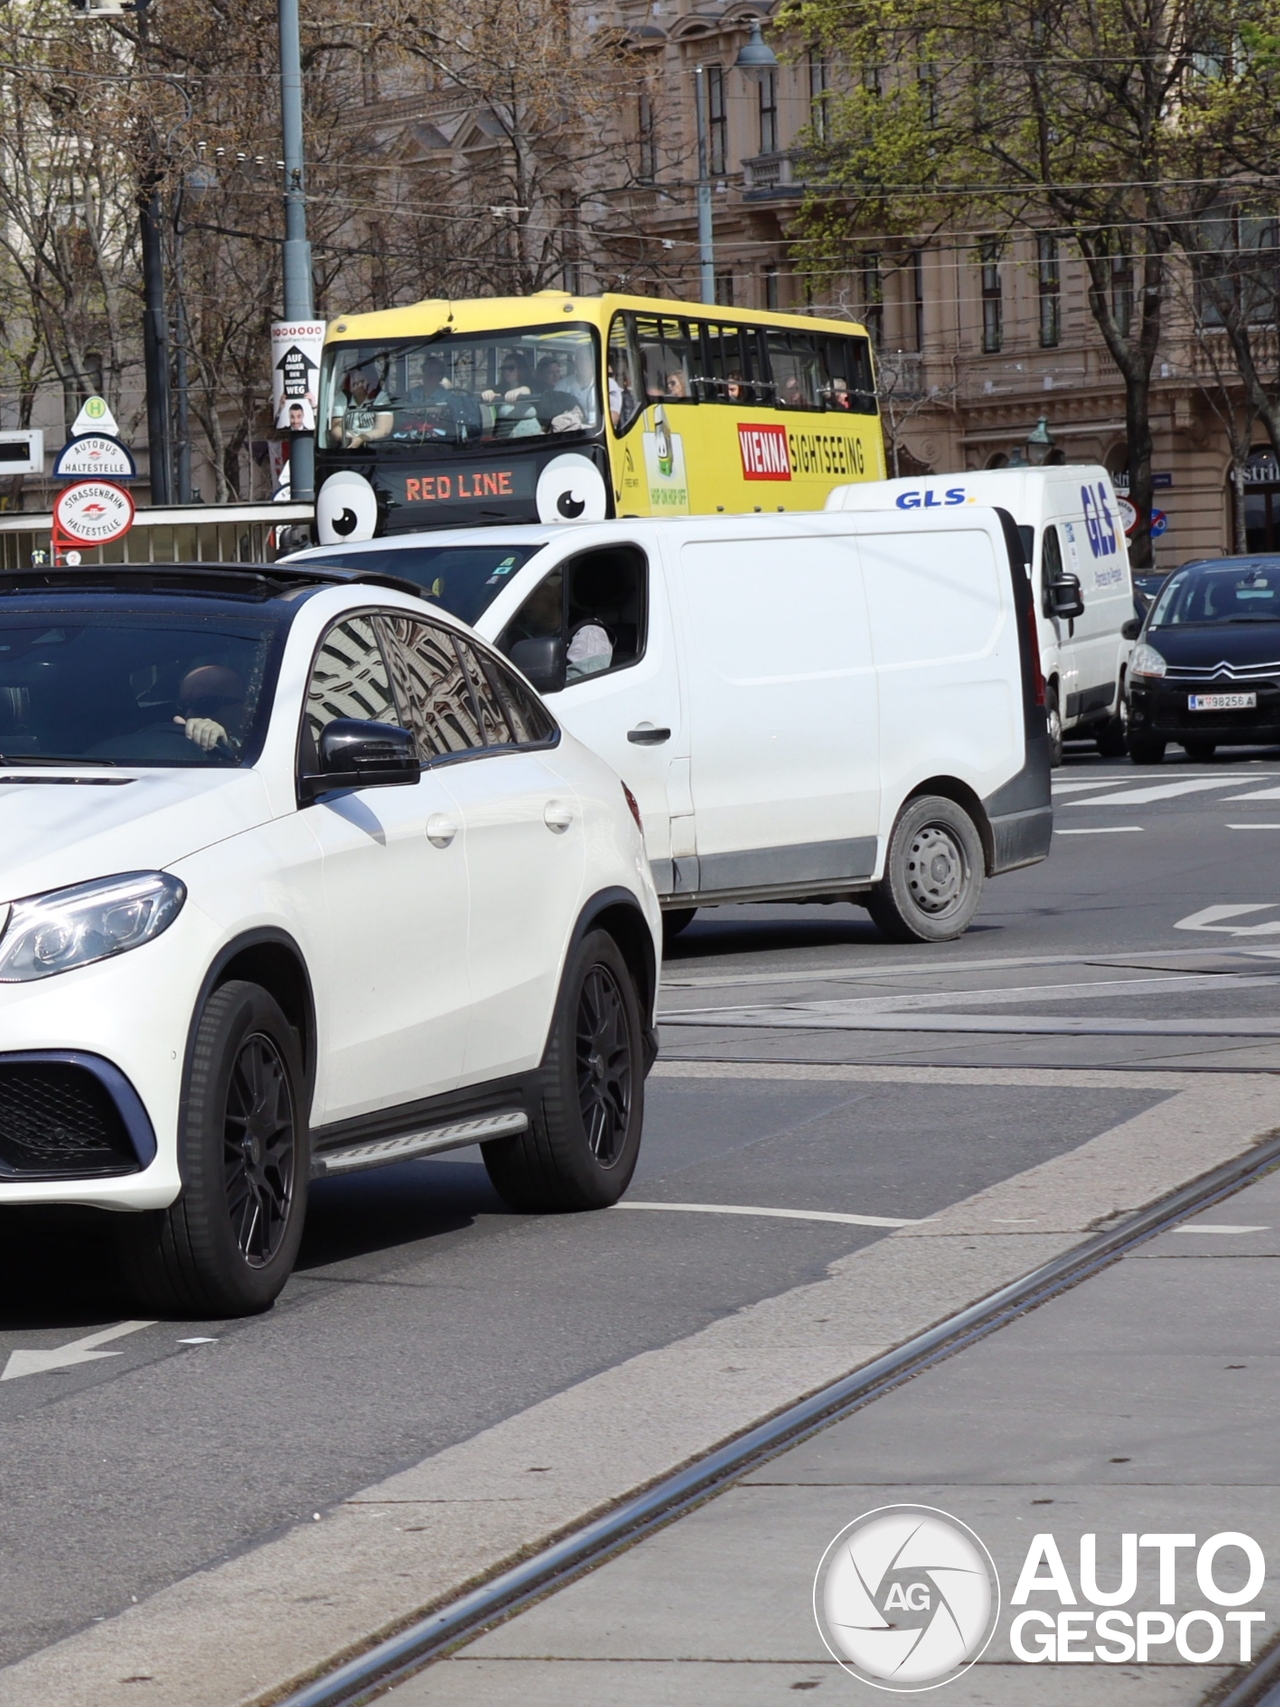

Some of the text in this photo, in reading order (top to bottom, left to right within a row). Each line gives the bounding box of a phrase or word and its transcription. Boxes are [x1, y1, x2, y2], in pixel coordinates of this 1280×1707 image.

[286, 354, 302, 363] AUF
[286, 386, 305, 394] WEG
[74, 440, 118, 456] AUTOBUS
[739, 431, 864, 474] VIENNA SIGHTSEEING
[65, 464, 124, 473] HALTESTELLE
[406, 471, 514, 501] RED LINE
[65, 488, 125, 509] STRASSENBAHN
[651, 488, 660, 505] HOP
[669, 488, 677, 505] HOP
[67, 518, 122, 536] HALTESTELLE
[70, 554, 77, 564] 2
